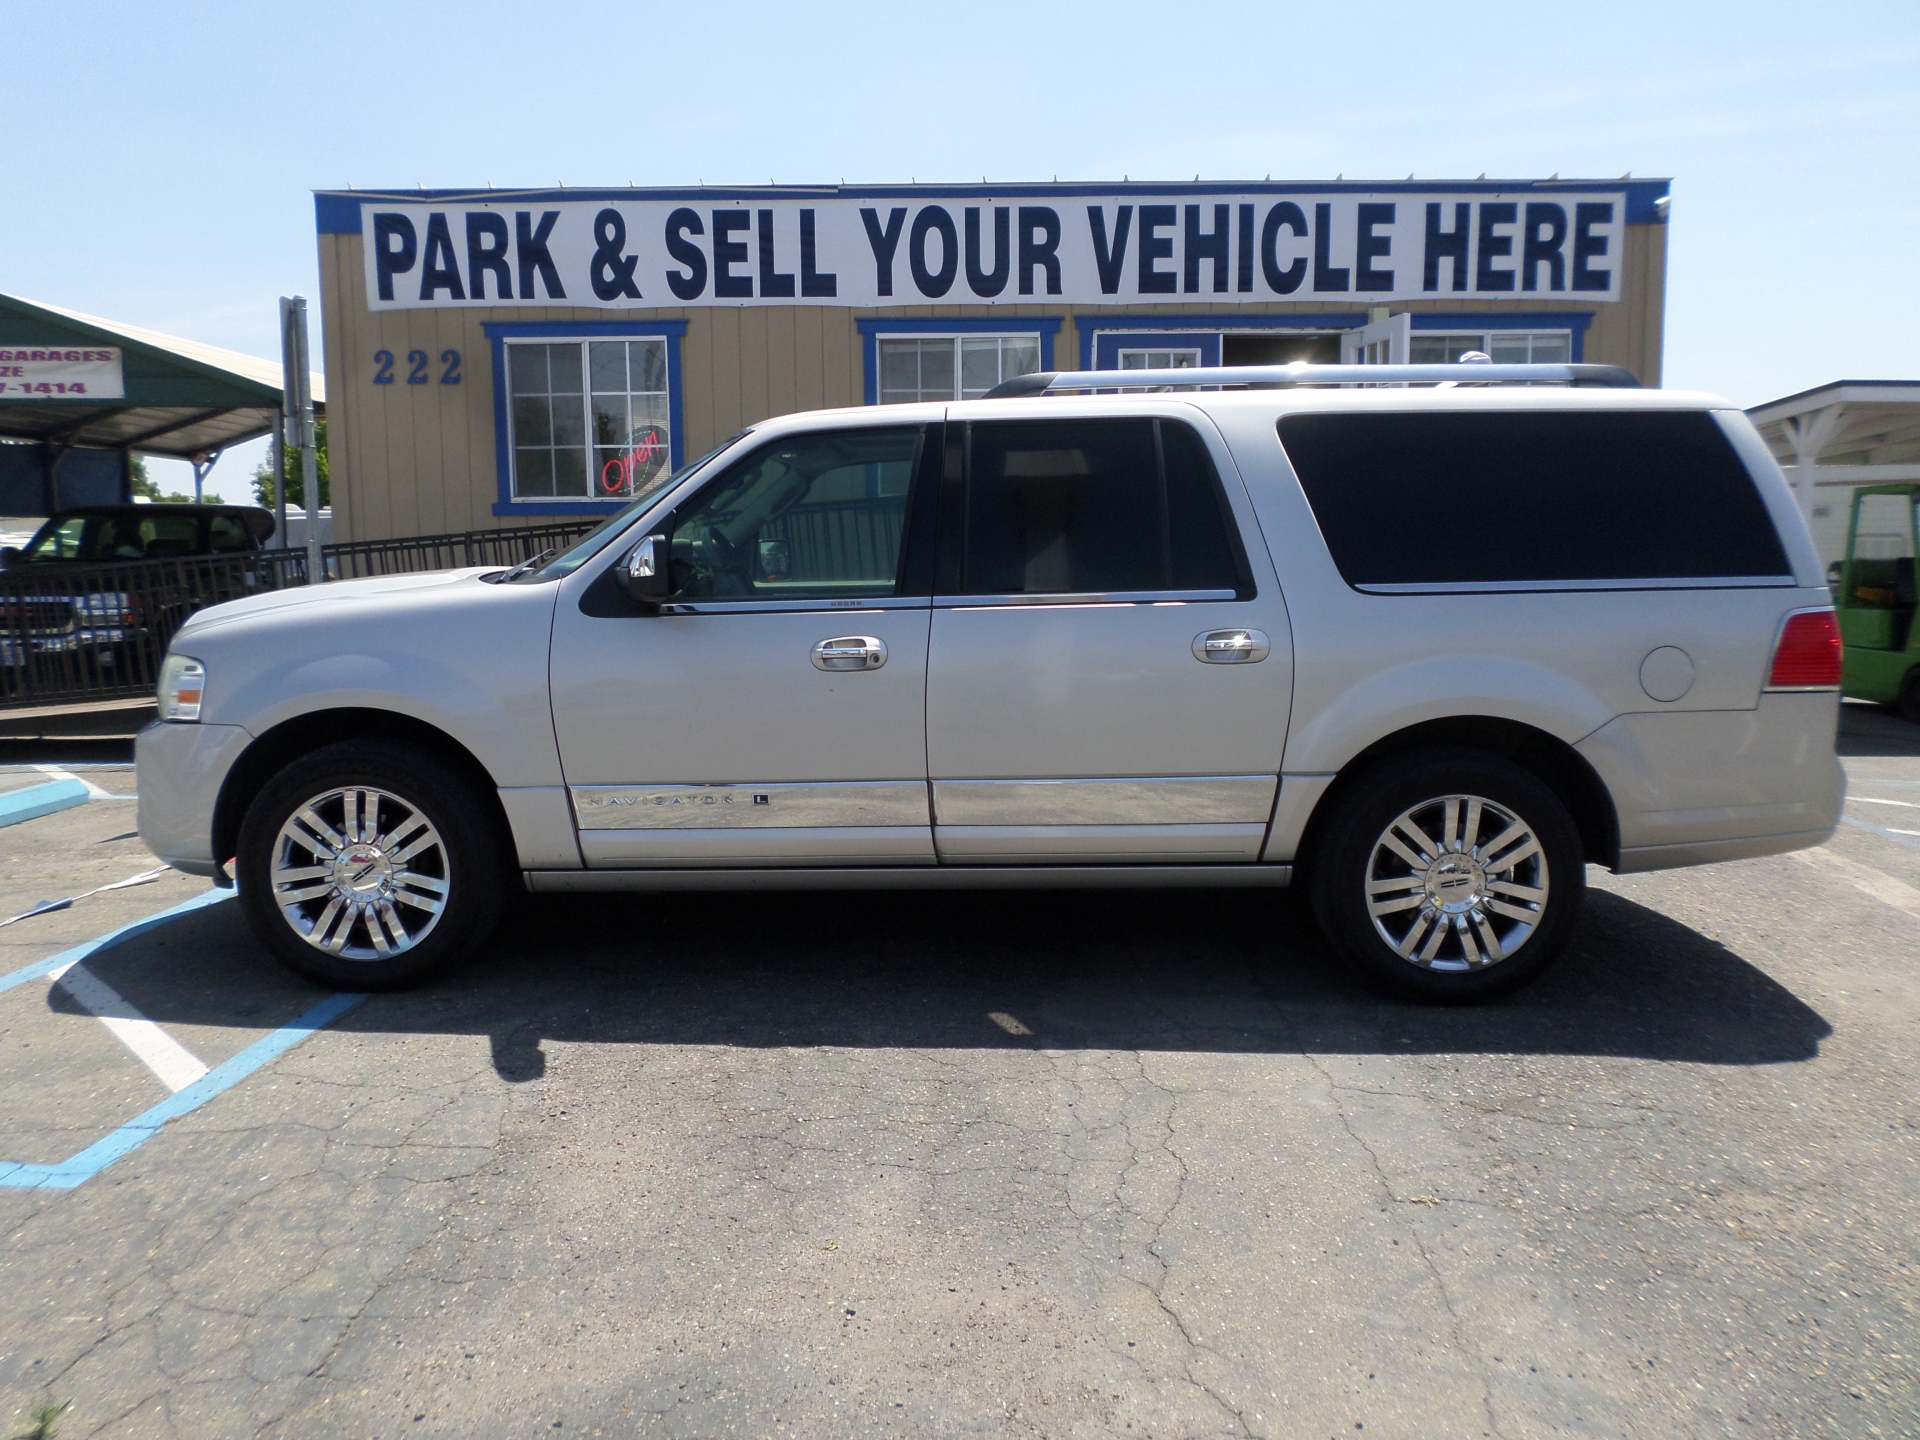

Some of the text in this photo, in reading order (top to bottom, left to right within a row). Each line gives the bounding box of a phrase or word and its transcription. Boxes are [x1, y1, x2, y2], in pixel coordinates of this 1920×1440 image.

[373, 201, 1614, 302] PARK & SELL YOUR VEHICLE HERE
[0, 350, 112, 361] GARAGES
[372, 348, 462, 385] 222
[602, 430, 660, 492] Open
[587, 795, 734, 806] NAVIGATOR
